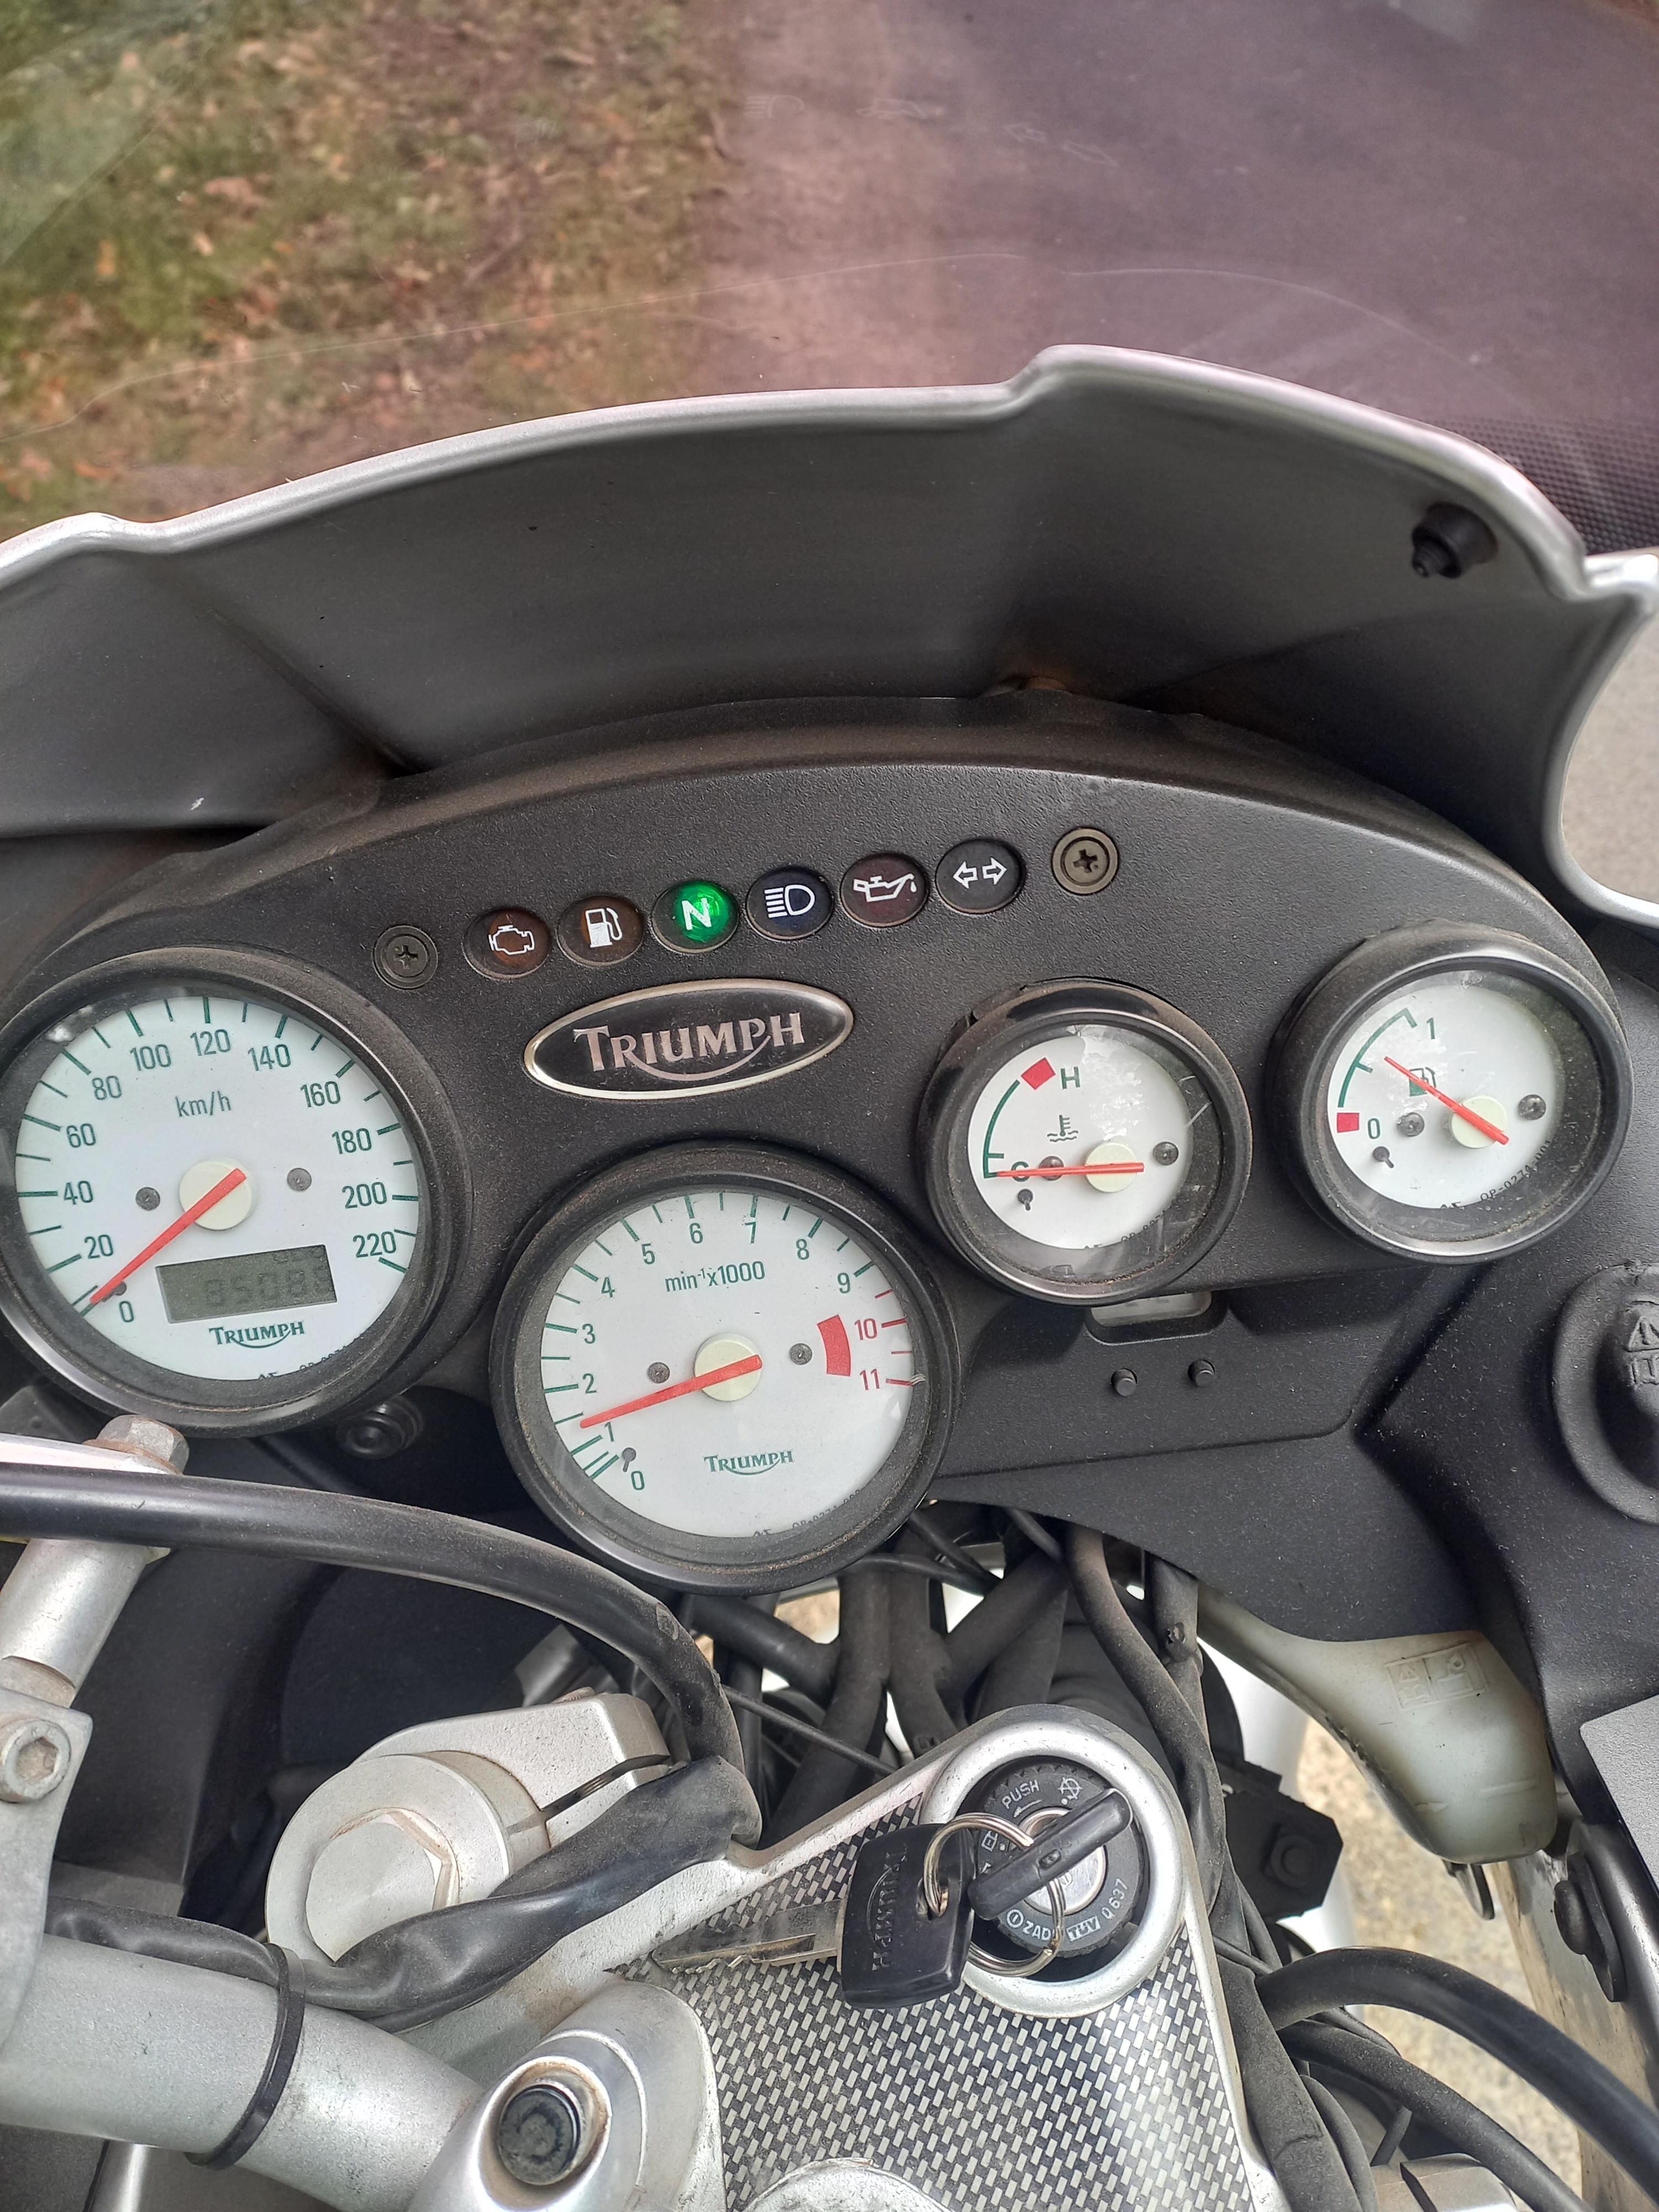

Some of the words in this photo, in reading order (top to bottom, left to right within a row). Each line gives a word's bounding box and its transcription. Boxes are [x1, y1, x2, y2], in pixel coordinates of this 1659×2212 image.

[683, 899, 712, 931] N
[1426, 1017, 1436, 1040] 1
[190, 1029, 232, 1056] 120
[573, 1011, 805, 1082] TRIUMPH
[129, 1044, 172, 1071] 100
[248, 1044, 291, 1071] 140
[91, 1075, 122, 1100] 80
[1060, 1066, 1081, 1089] H
[175, 1091, 232, 1118] km/h
[300, 1081, 341, 1108] 160
[66, 1123, 96, 1148] 60
[331, 1128, 372, 1155] 180
[1367, 1118, 1381, 1140] 0
[64, 1180, 93, 1205] 40
[342, 1181, 388, 1209] 200
[353, 1231, 397, 1258] 220
[689, 1222, 703, 1244] 6
[744, 1221, 757, 1244] 7
[84, 1234, 114, 1259] 20
[641, 1243, 655, 1265] 5
[796, 1238, 810, 1260] 8
[601, 1276, 615, 1298] 4
[837, 1272, 851, 1294] 9
[118, 1300, 135, 1323] 0
[208, 1321, 305, 1349] TRIUMPH
[582, 1323, 596, 1344] 3
[854, 1318, 878, 1340] 10
[582, 1373, 597, 1394] 2
[859, 1368, 880, 1391] 11
[604, 1421, 614, 1442] 1
[703, 1451, 794, 1476] TRIUMPH
[630, 1470, 645, 1491] 0
[1001, 1779, 1040, 1809] PUSH
